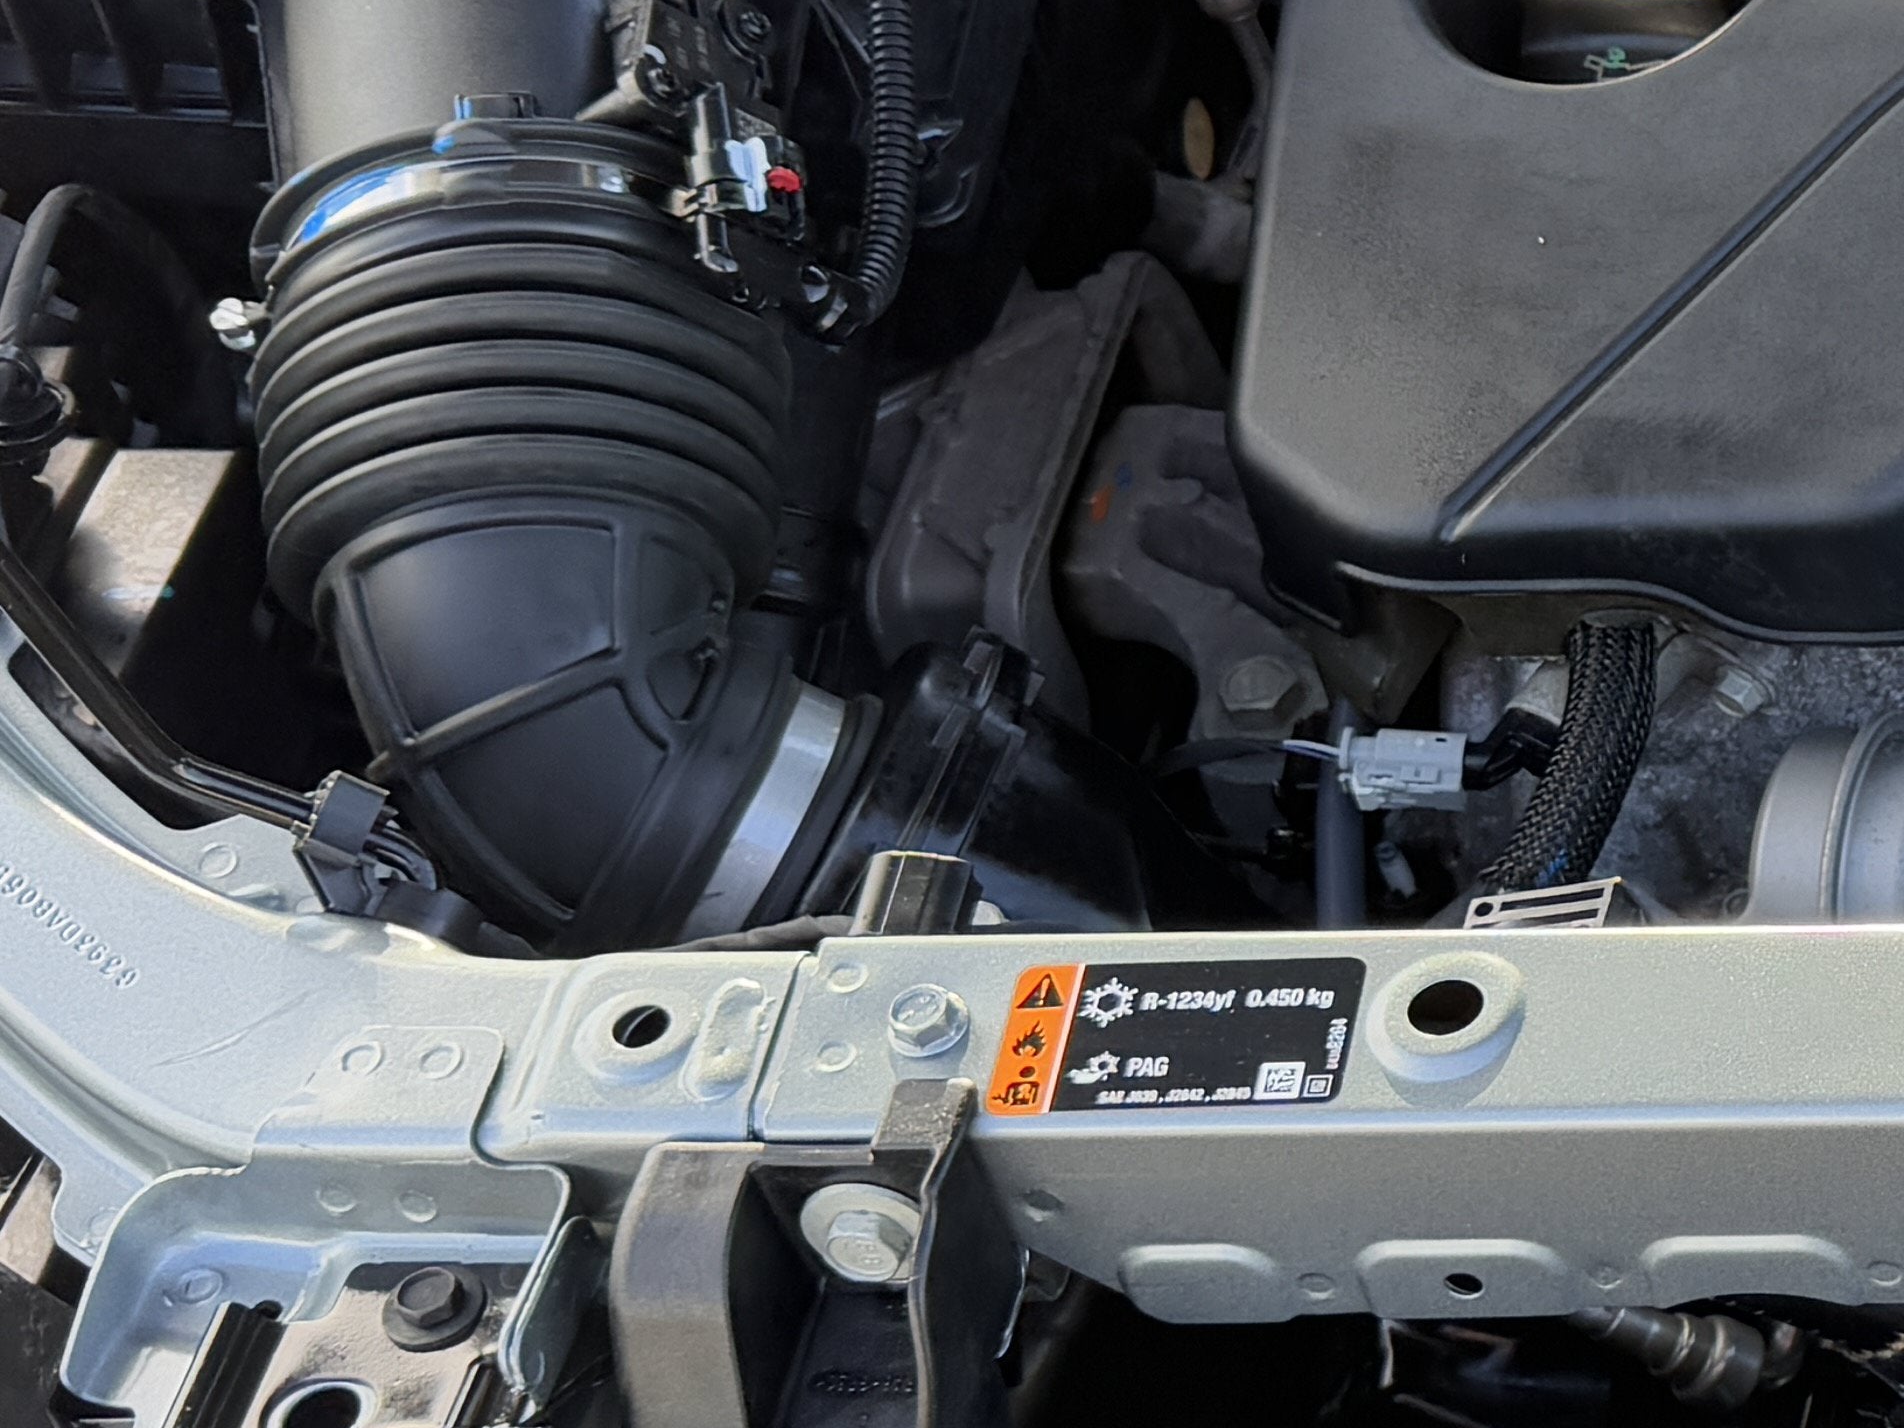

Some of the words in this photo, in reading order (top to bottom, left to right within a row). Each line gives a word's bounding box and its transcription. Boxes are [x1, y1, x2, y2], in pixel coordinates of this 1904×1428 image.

[1140, 989, 1235, 1013] R-1234yf
[1245, 988, 1304, 1007] 0.450
[1306, 987, 1335, 1009] kg
[1124, 1056, 1170, 1078] PAG
